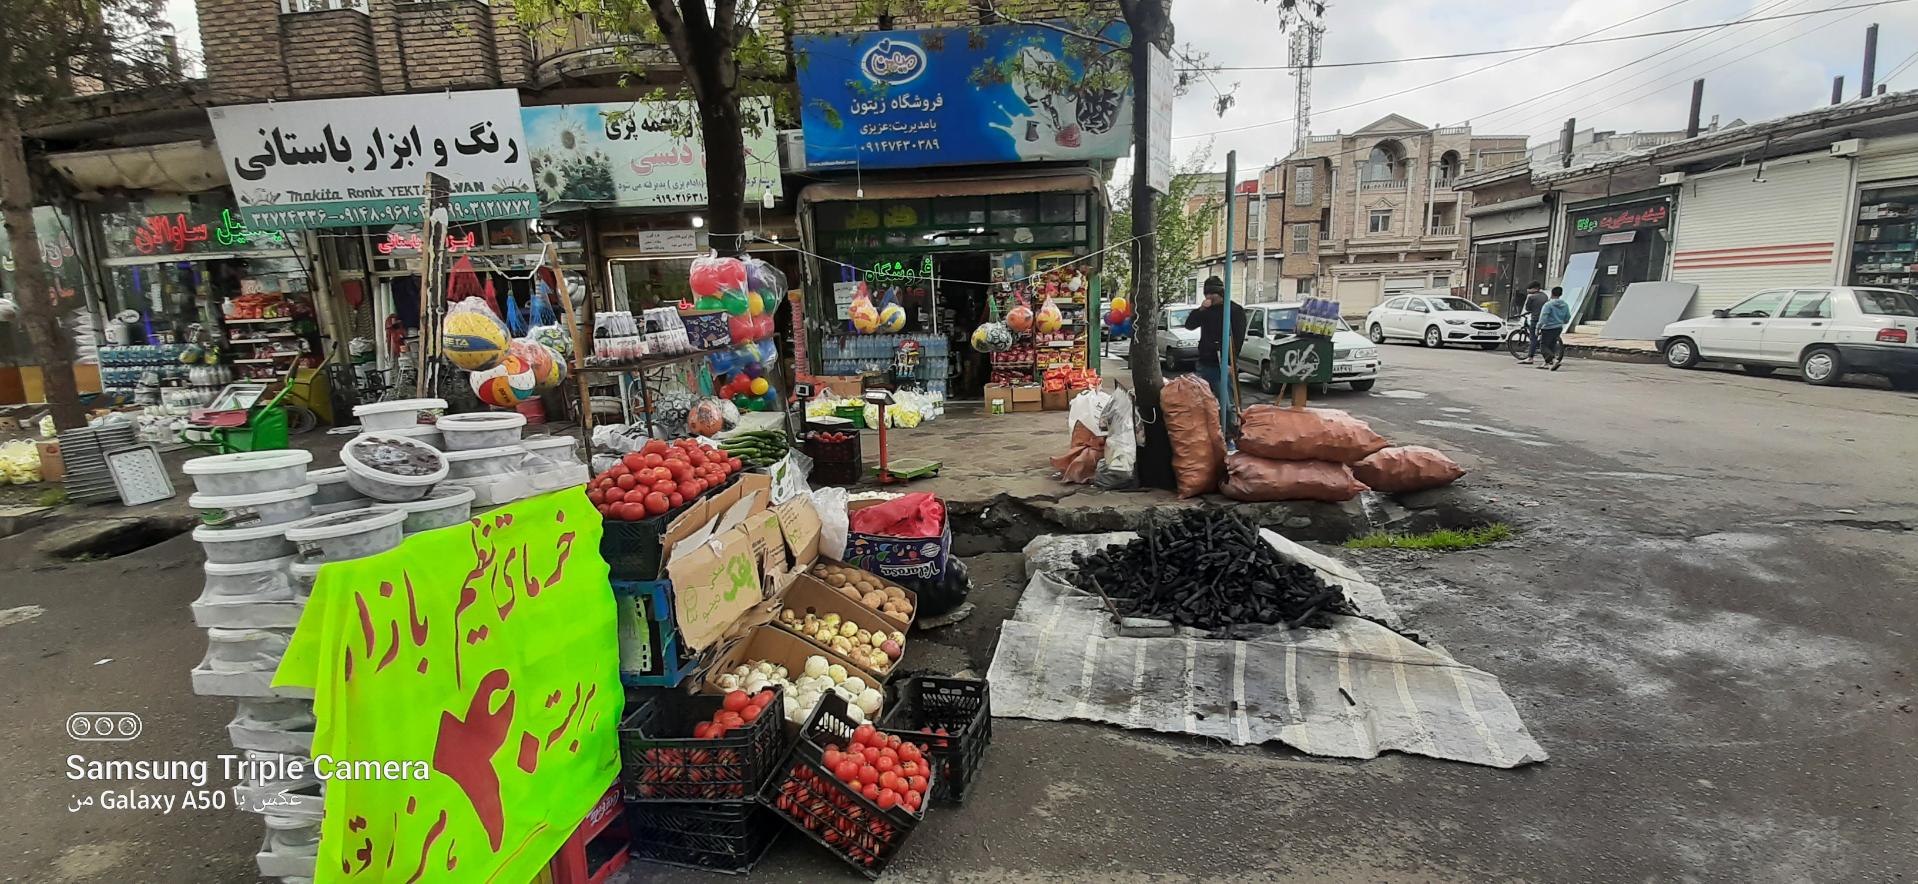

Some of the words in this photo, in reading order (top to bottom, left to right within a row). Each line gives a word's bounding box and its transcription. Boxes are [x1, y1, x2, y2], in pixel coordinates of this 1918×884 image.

[850, 97, 887, 115] زیتون
[890, 92, 944, 112] فروشگاه
[234, 123, 356, 181] باستانی
[363, 124, 422, 171] ابزار
[434, 137, 449, 167] و
[453, 121, 519, 164] رنگ
[860, 138, 940, 152] ۰۹۱۴۷۴۳۰۳۸۹
[347, 185, 384, 199] Ronix
[388, 185, 428, 197] YEKT
